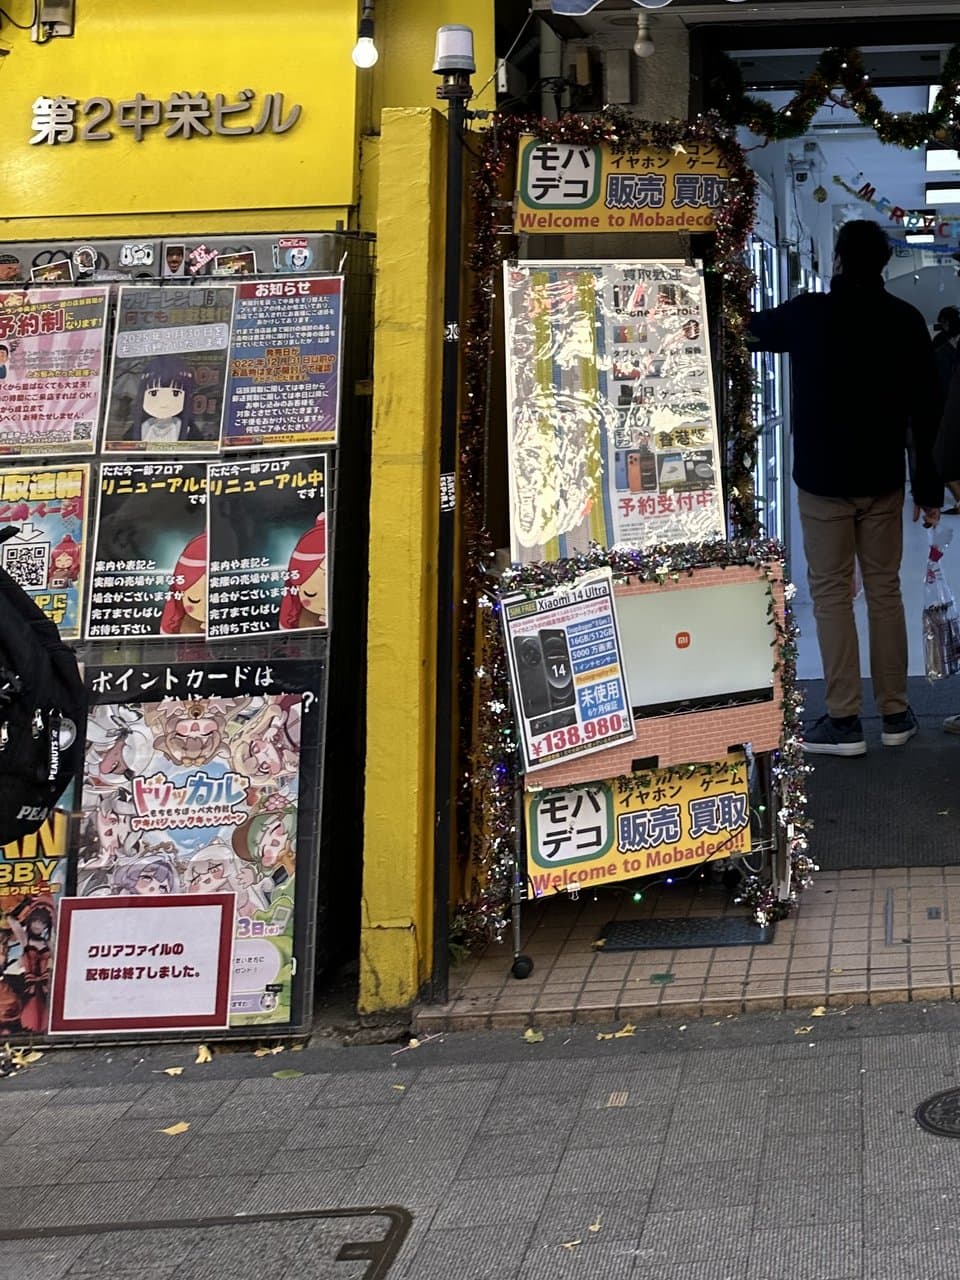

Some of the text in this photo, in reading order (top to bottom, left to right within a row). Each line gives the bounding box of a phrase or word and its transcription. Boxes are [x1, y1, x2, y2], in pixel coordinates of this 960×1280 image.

[29, 88, 303, 145] 第2中栄ビル
[532, 146, 592, 171] モバ
[611, 156, 670, 169] イヤホン
[531, 175, 589, 201] デコ
[605, 173, 666, 208] 販売
[520, 212, 600, 229] Welcome
[608, 213, 625, 227] to
[255, 281, 311, 296] お知らせ
[102, 464, 184, 476] ただ今一部フロア
[209, 461, 290, 477] ただ今一部フロア
[209, 470, 324, 497] リニューアル中
[618, 492, 713, 518] 予約受付中
[93, 574, 186, 588] 実際の売場が異なる
[208, 569, 301, 588] 実際の売場が異なる
[91, 590, 184, 604] 場合がございますが
[208, 586, 301, 604] 場合がございますが
[538, 596, 570, 611] Xiaomi
[572, 590, 584, 603] 14
[585, 585, 608, 599] Ultra
[90, 608, 163, 620] 完了までしばし
[208, 605, 280, 620] 完了までしばし
[90, 624, 152, 637] お待ち下さい
[208, 620, 271, 637] お待ち下さい
[91, 666, 275, 694] ポイントカードは
[551, 663, 567, 678] 14
[581, 680, 620, 708] 未使用
[531, 714, 623, 757] ¥138,980
[618, 773, 744, 808] イヤホン ゲーム
[540, 790, 602, 824] モバ
[616, 791, 750, 853] 販売 買取
[543, 826, 602, 859] デコ
[533, 834, 745, 892] Welcome to Mobadeco!!
[87, 942, 184, 958] クリアファイルの
[85, 965, 201, 982] 配布は終了しました。
